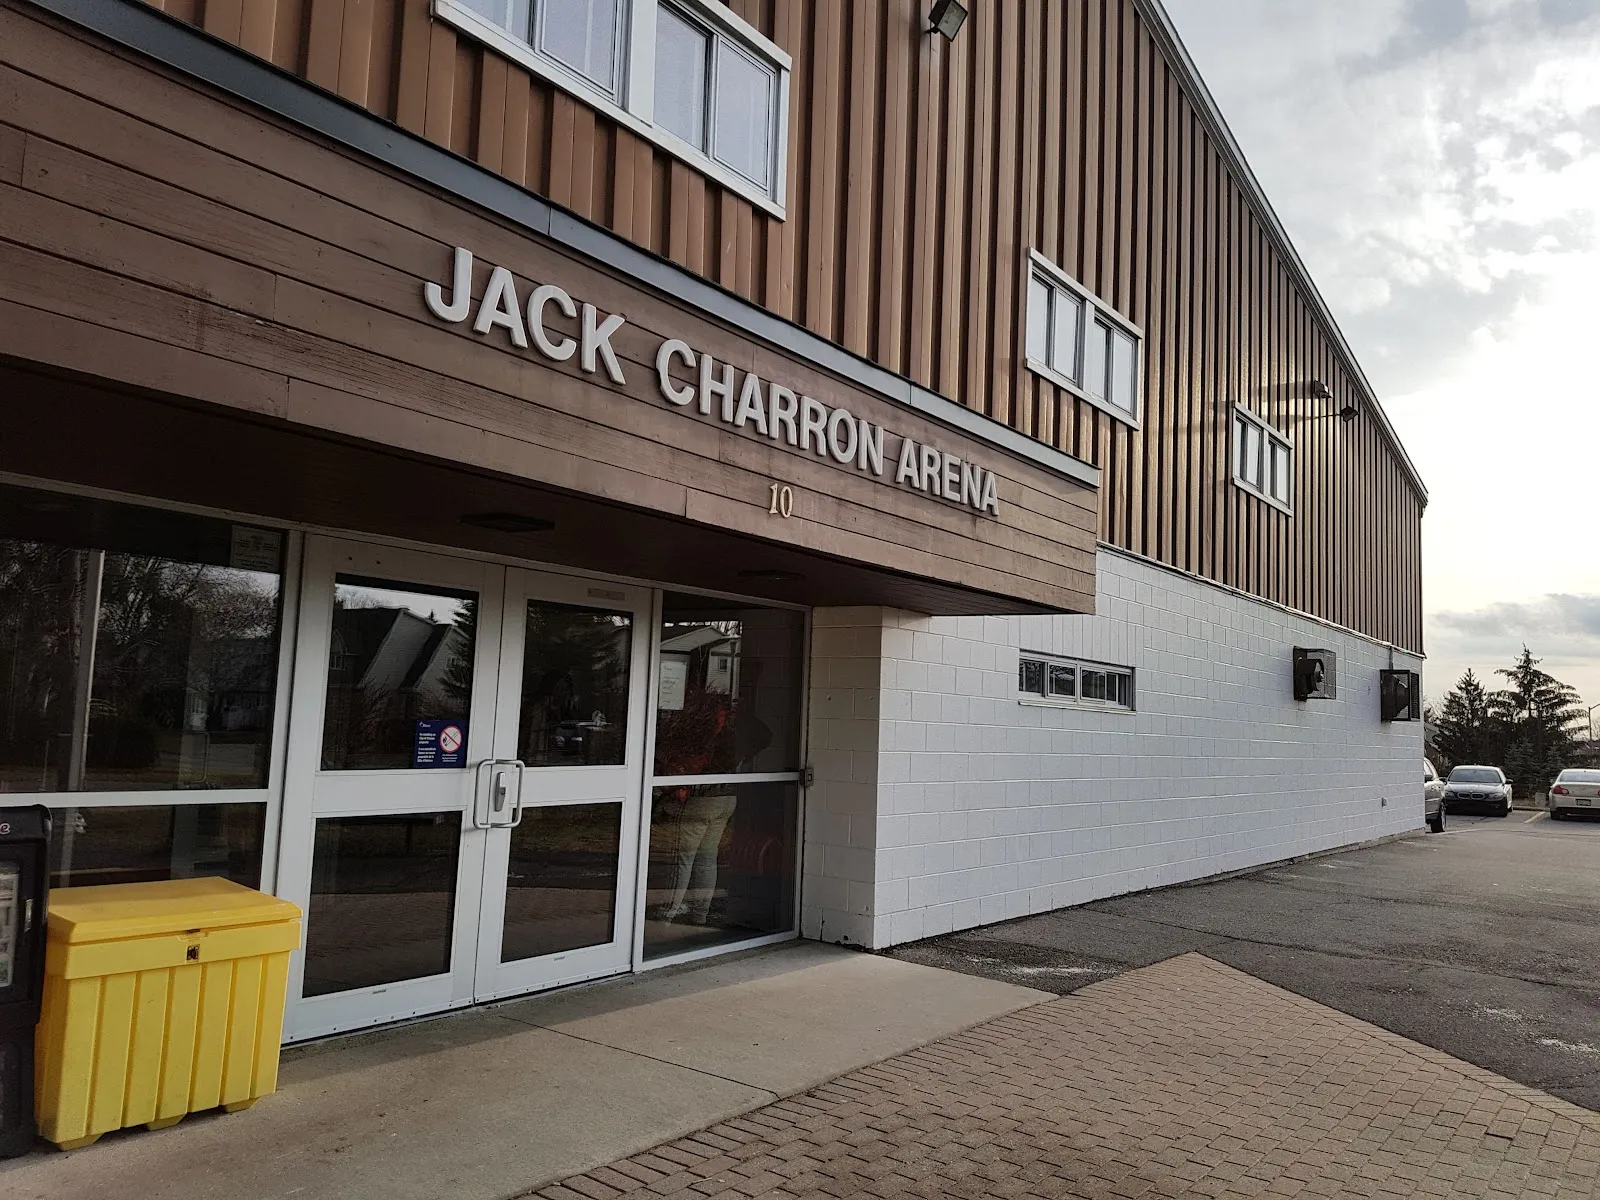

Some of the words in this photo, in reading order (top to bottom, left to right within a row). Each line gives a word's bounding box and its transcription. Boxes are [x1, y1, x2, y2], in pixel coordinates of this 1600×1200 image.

[425, 246, 627, 385] JACK
[656, 338, 884, 476] CHARRON
[897, 438, 1000, 516] ARENA
[769, 484, 793, 518] 10
